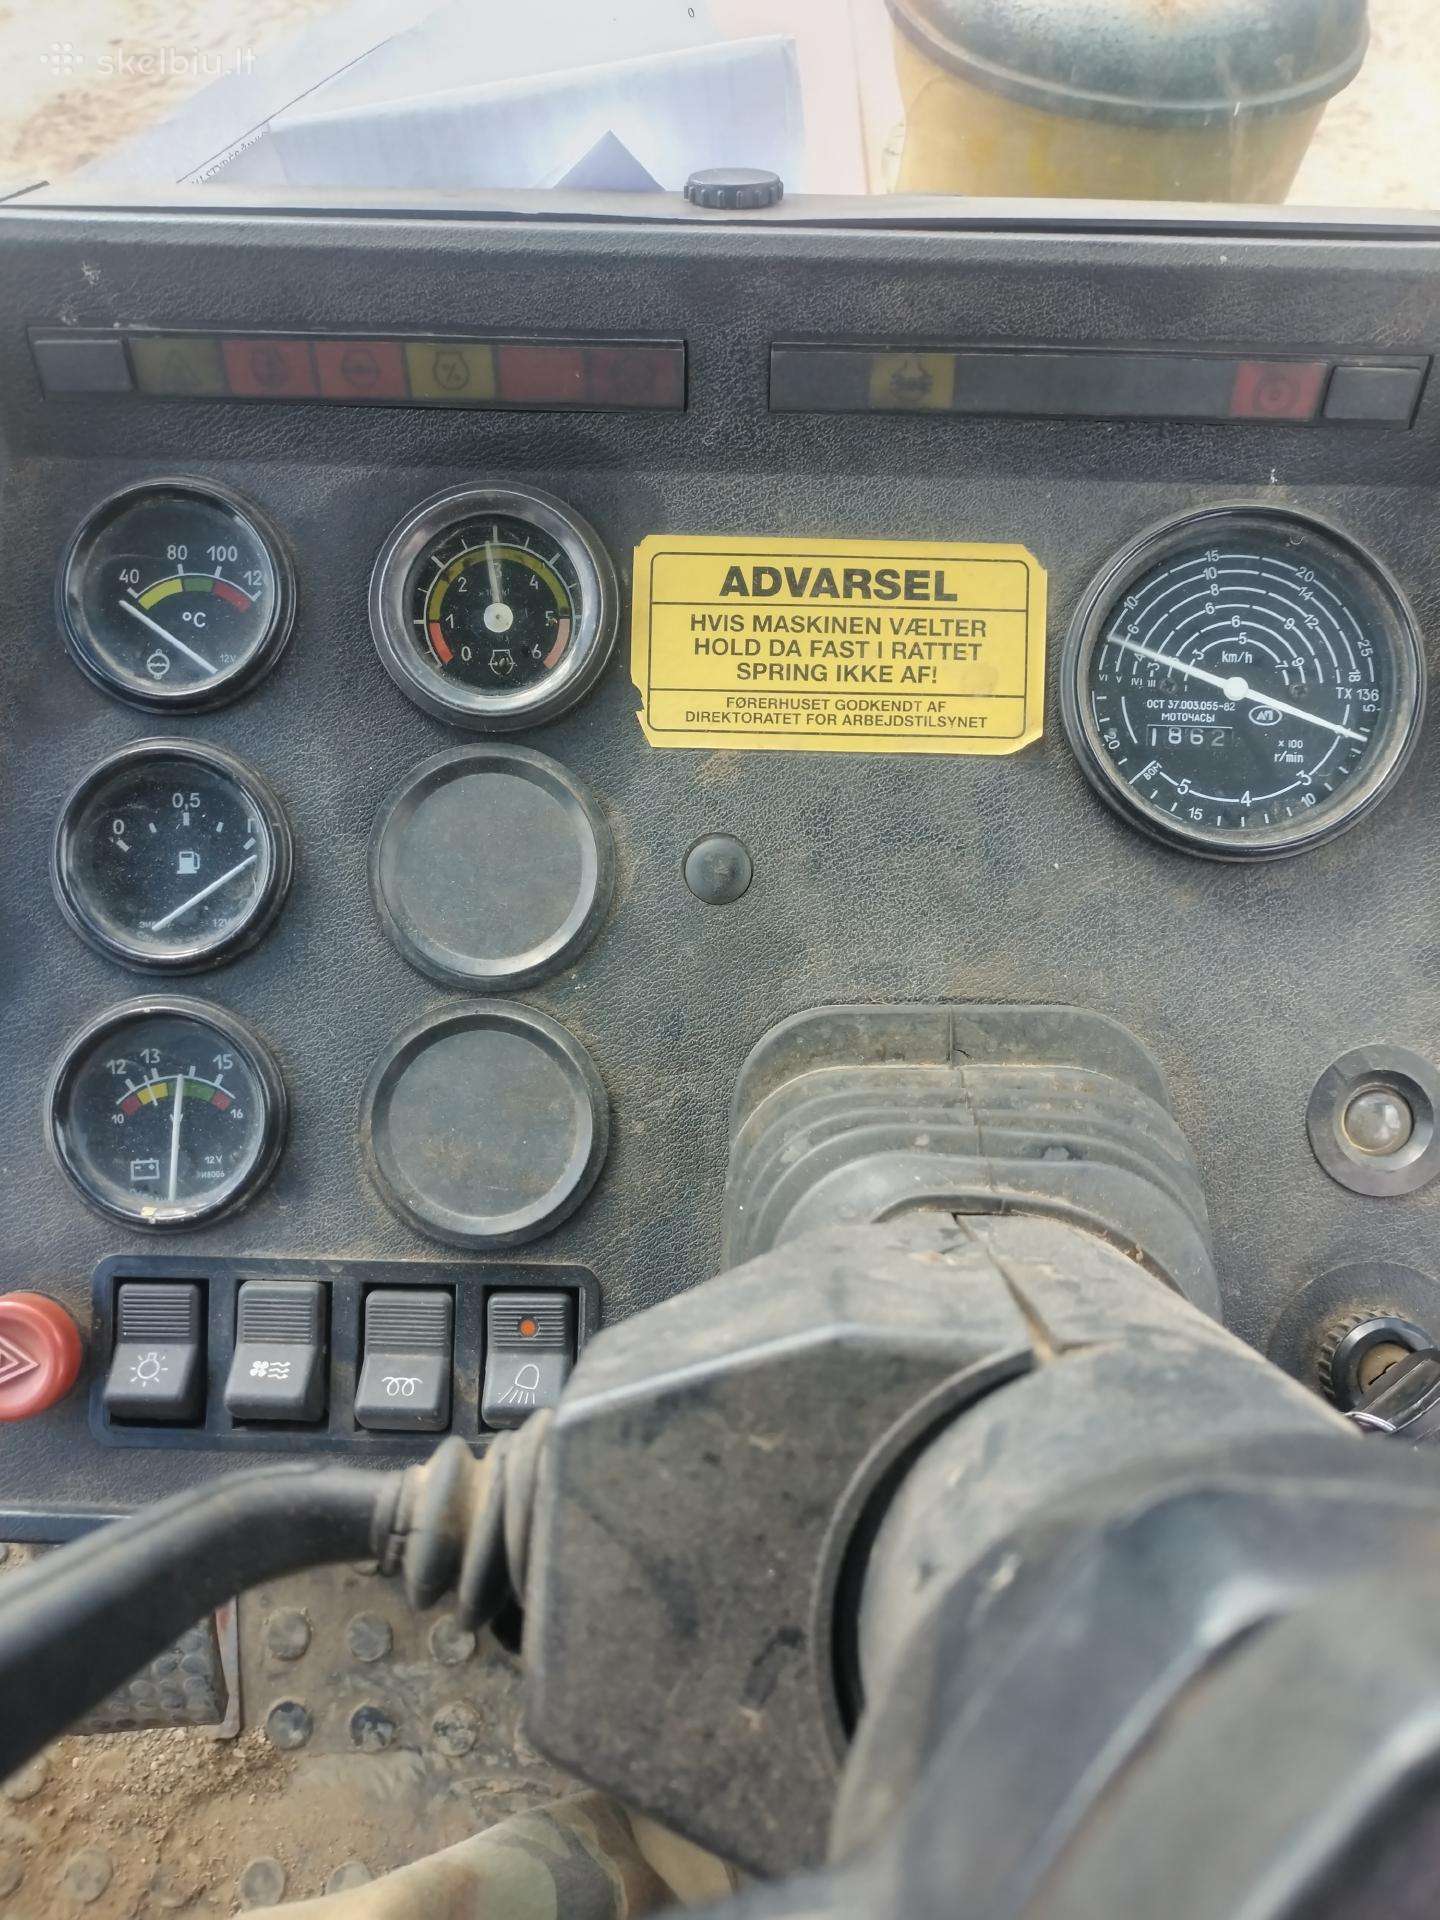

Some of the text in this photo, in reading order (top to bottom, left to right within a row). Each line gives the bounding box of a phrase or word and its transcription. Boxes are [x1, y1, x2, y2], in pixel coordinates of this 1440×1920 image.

[166, 544, 189, 561] 80
[206, 545, 239, 563] 100
[1204, 550, 1219, 562] 15
[118, 568, 140, 584] 40
[243, 570, 266, 586] 12
[1203, 566, 1218, 580] 10
[1295, 566, 1315, 582] 20
[457, 577, 467, 592] 2
[529, 574, 540, 590] 4
[719, 565, 958, 602] ADVARSEL
[1210, 583, 1220, 596] 8
[1298, 586, 1314, 601] 14
[1123, 596, 1138, 610] 10
[1205, 602, 1215, 615] 6
[182, 611, 207, 628] °C
[445, 613, 454, 628] 1
[690, 613, 987, 638] HVIS MASKINEN VÆLTER
[1231, 615, 1241, 628] 6
[1283, 617, 1295, 630] 9
[1303, 614, 1319, 630] 12
[1127, 623, 1140, 635] 6
[1238, 632, 1248, 645] 5
[461, 645, 472, 662] 0
[531, 643, 542, 660] 6
[694, 637, 983, 661] HOLD DA FAST I RATTET
[1191, 648, 1205, 660] 3
[1357, 639, 1374, 657] 25
[1221, 650, 1253, 664] km/h
[736, 662, 938, 684] SPRING IKKE AF!
[1348, 669, 1362, 683] 18
[1356, 688, 1380, 702] 136
[726, 697, 947, 713] FØRERHUSET GODKENDT AF
[685, 711, 988, 729] DIREKTORATET FOR ARBEJDSTILSYNET
[1160, 712, 1216, 723] МОТОЧАСЫ
[1103, 731, 1121, 750] 20
[1273, 750, 1305, 763] r/min
[1296, 769, 1312, 786] 3
[1177, 778, 1192, 795] 5
[1240, 790, 1252, 807] 4
[1301, 792, 1316, 808] 10
[1188, 806, 1204, 820] 15
[112, 818, 126, 836] 0
[140, 1047, 161, 1064] 13
[212, 1053, 234, 1070] 15
[106, 1059, 128, 1075] 12
[111, 1113, 125, 1125] 10
[230, 1108, 244, 1120] 16
